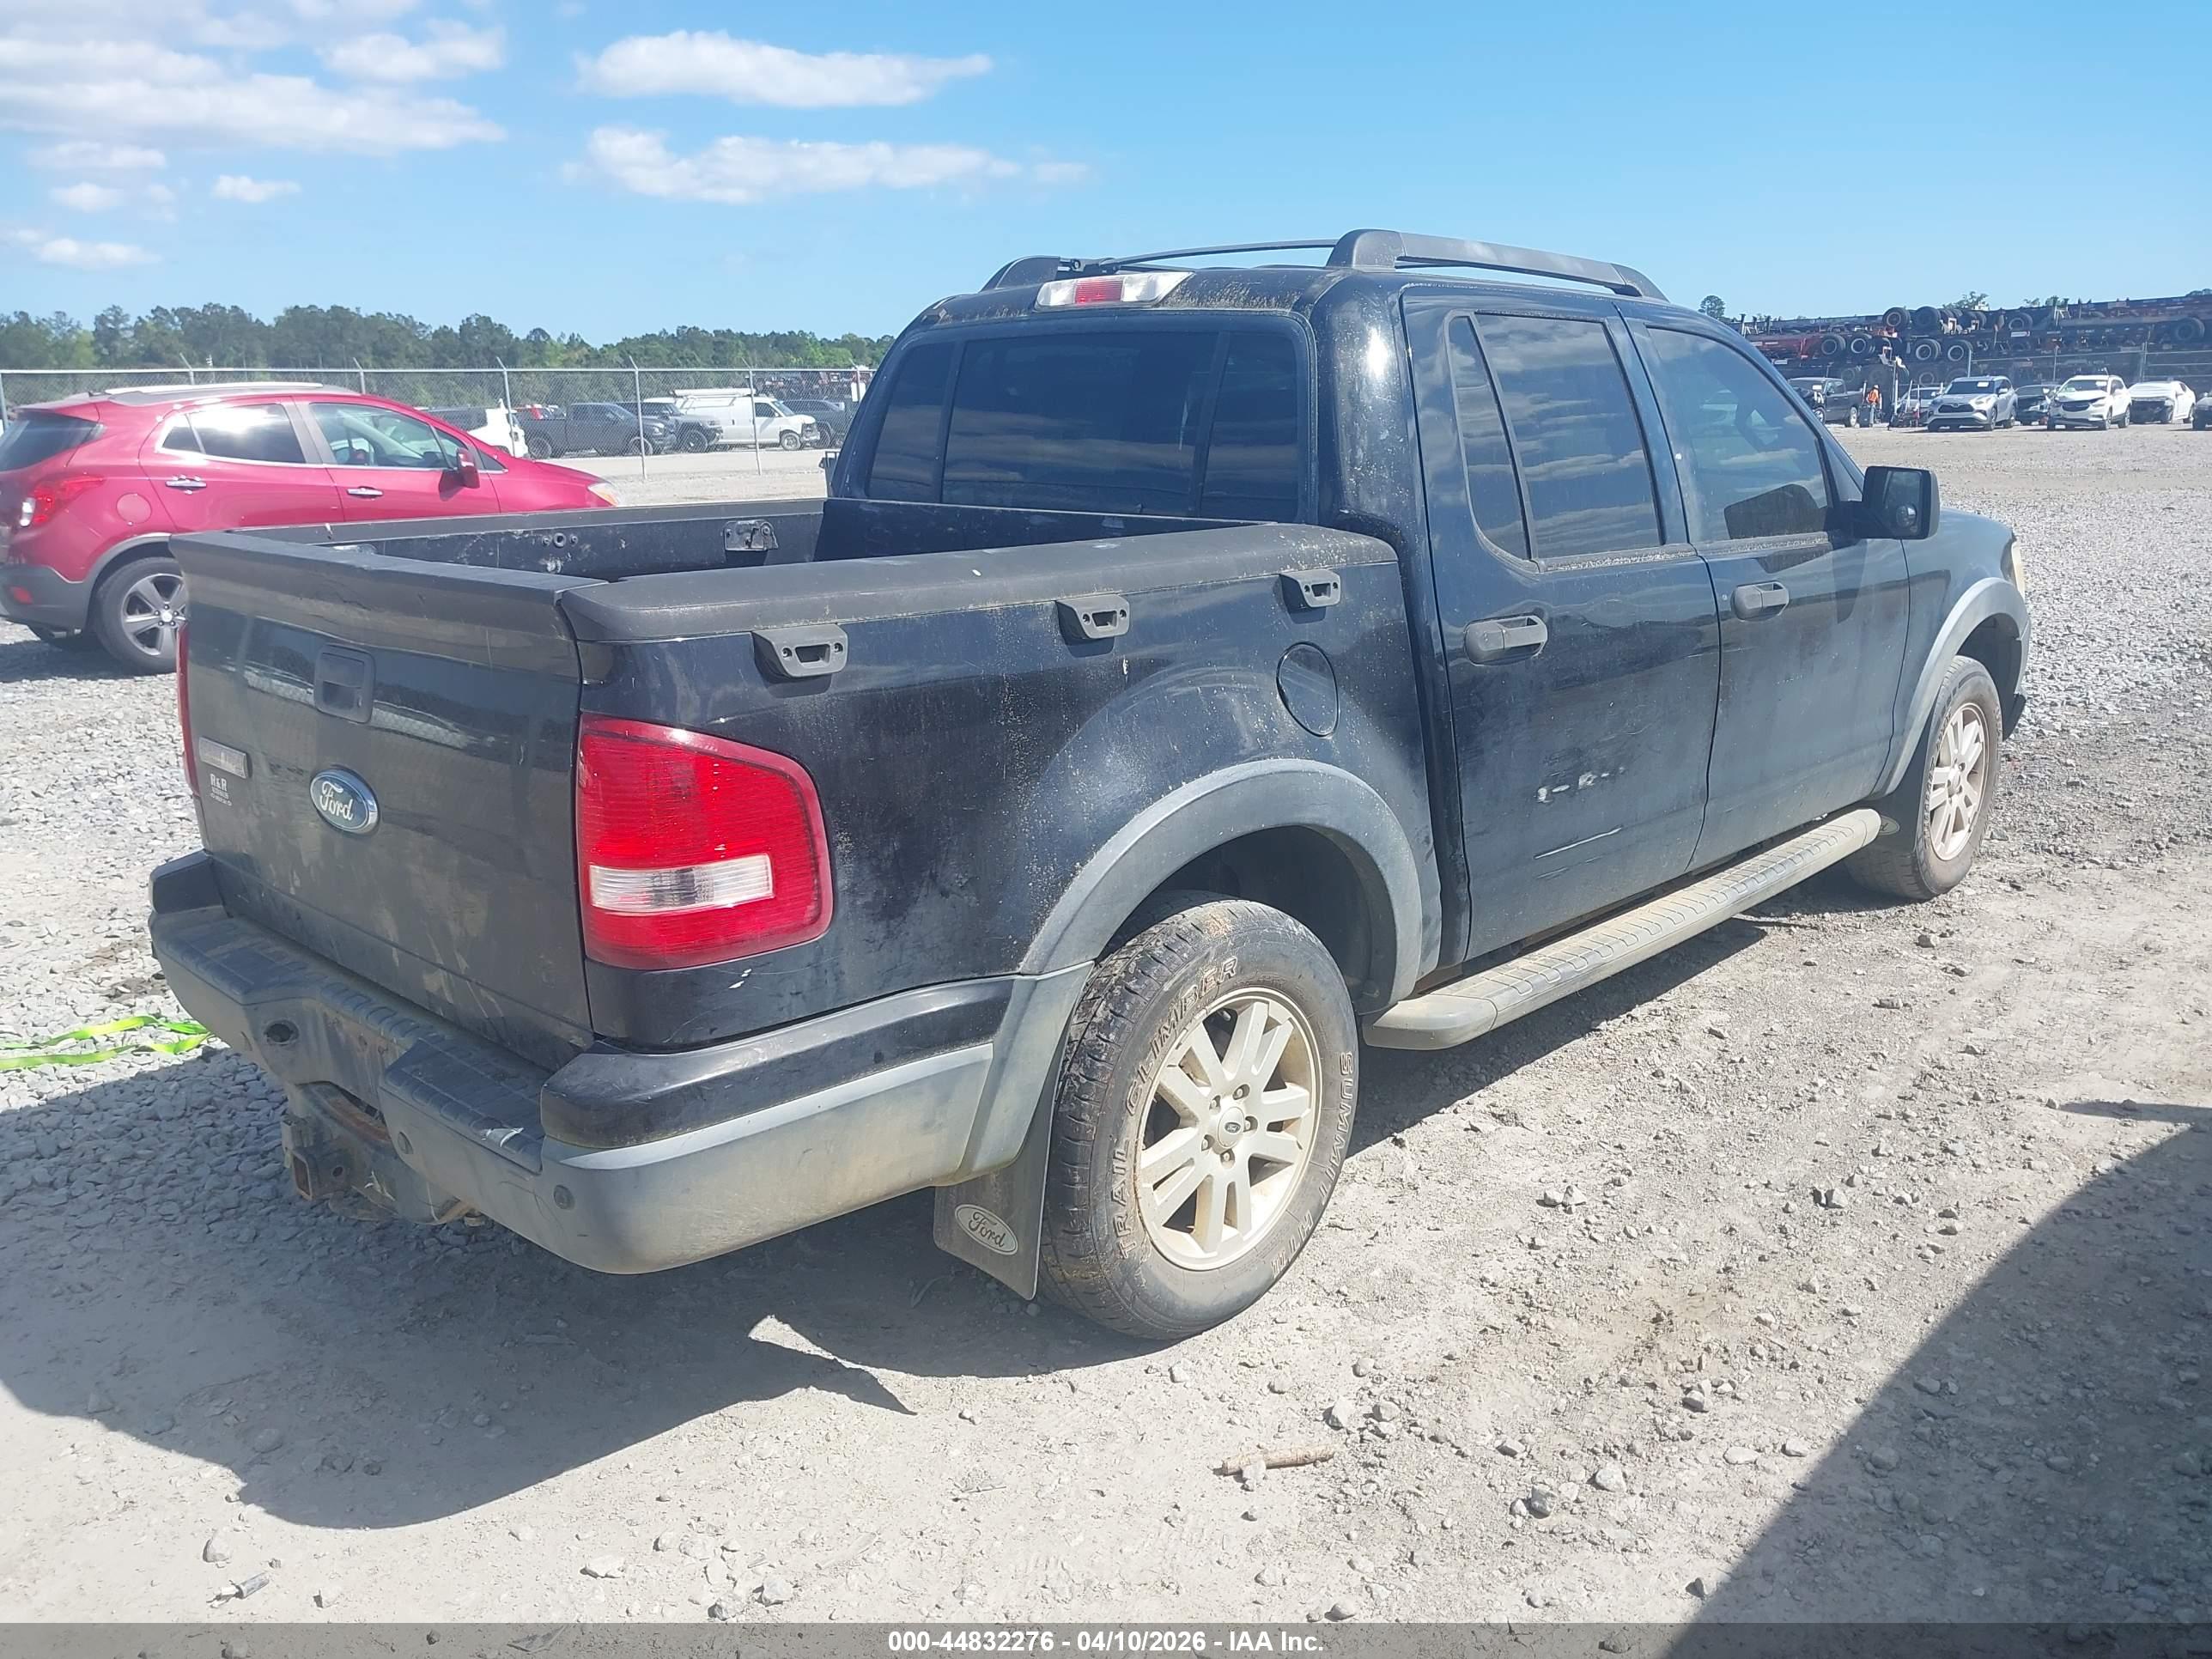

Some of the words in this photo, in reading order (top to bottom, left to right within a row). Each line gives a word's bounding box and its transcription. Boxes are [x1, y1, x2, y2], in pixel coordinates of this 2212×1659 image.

[319, 780, 355, 822] Ford
[1112, 1139, 1137, 1261] TRAIL
[1127, 956, 1237, 1116] CLIMBER
[1317, 1050, 1355, 1206] SUMMIT
[968, 1211, 1006, 1248] Ford
